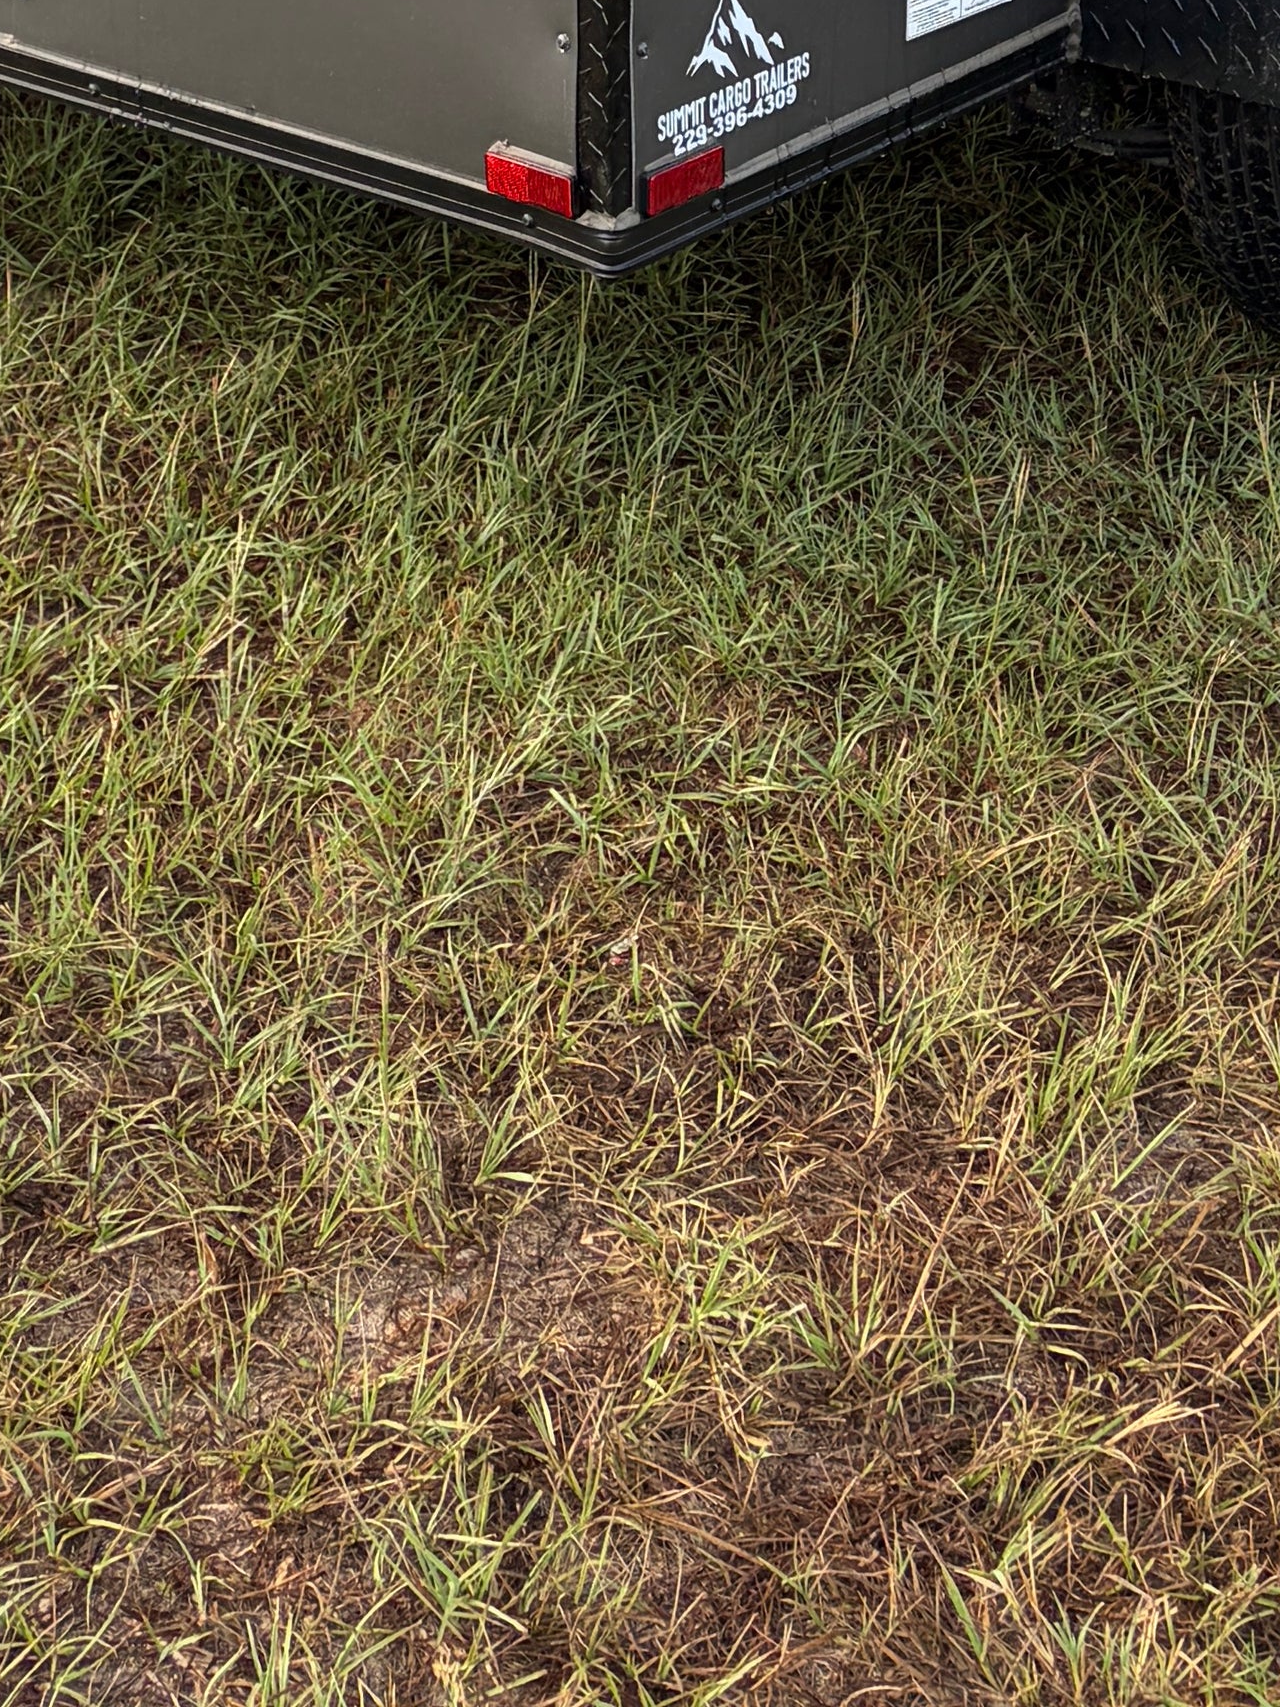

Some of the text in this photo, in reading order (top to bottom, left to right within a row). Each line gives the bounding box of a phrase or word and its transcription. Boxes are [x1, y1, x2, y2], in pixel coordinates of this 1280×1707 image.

[657, 51, 810, 142] SUMMIT CARGO TRAILERS
[672, 84, 798, 157] 229-396-4309
